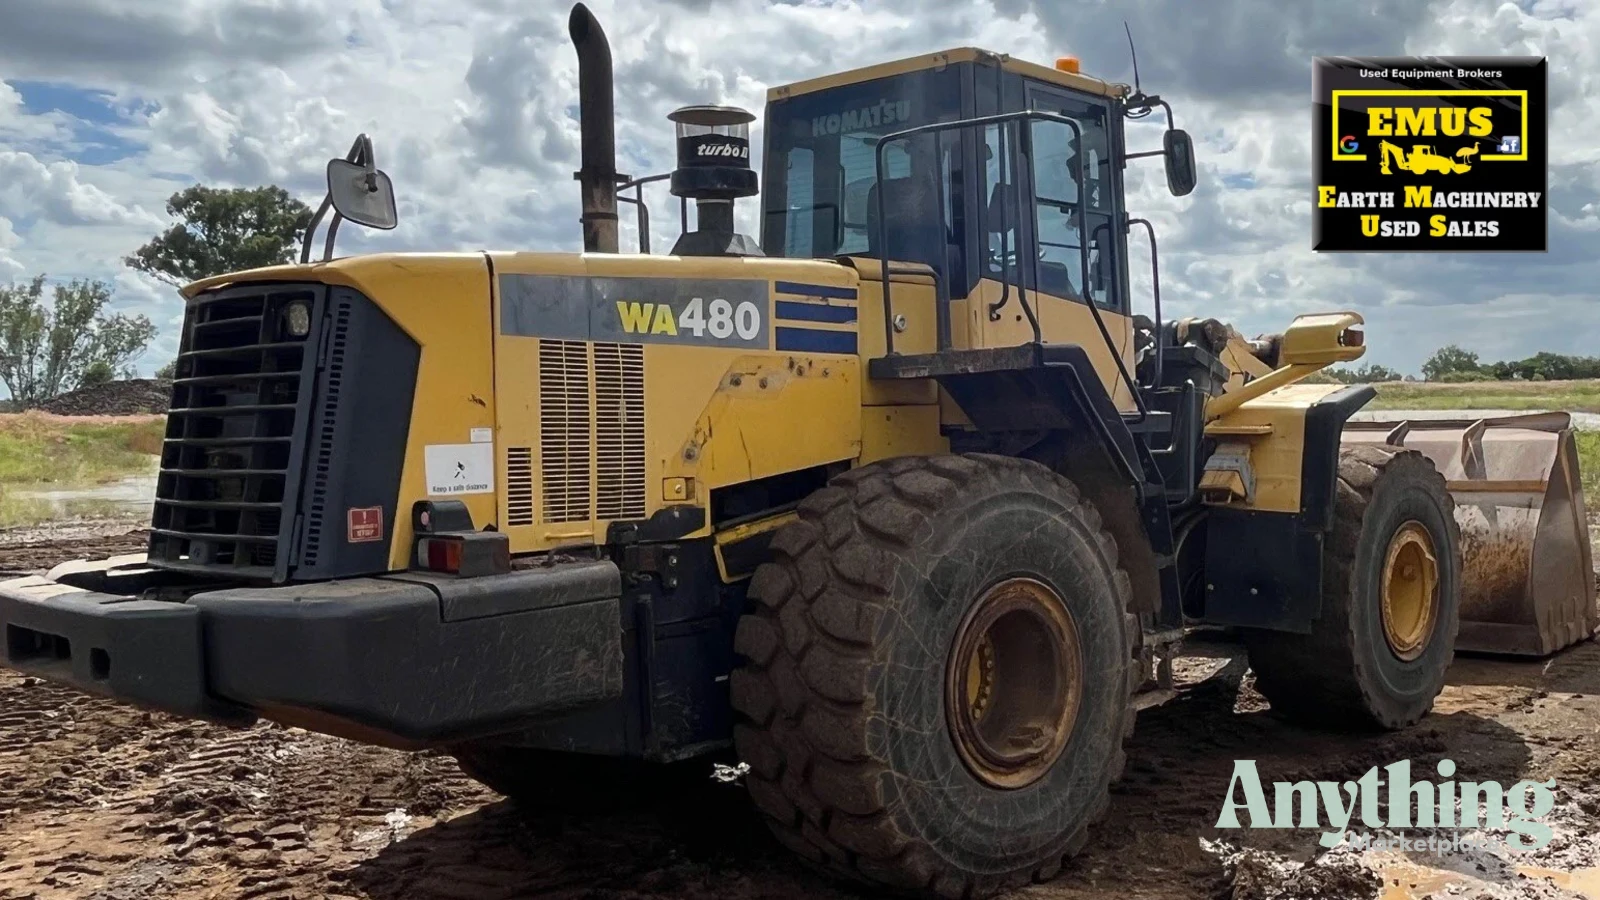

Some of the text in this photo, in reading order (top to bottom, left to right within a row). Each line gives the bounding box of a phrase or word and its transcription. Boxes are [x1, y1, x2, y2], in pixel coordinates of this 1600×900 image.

[812, 98, 911, 137] KOMATSU
[697, 143, 740, 157] turbo
[616, 298, 761, 341] WA480
